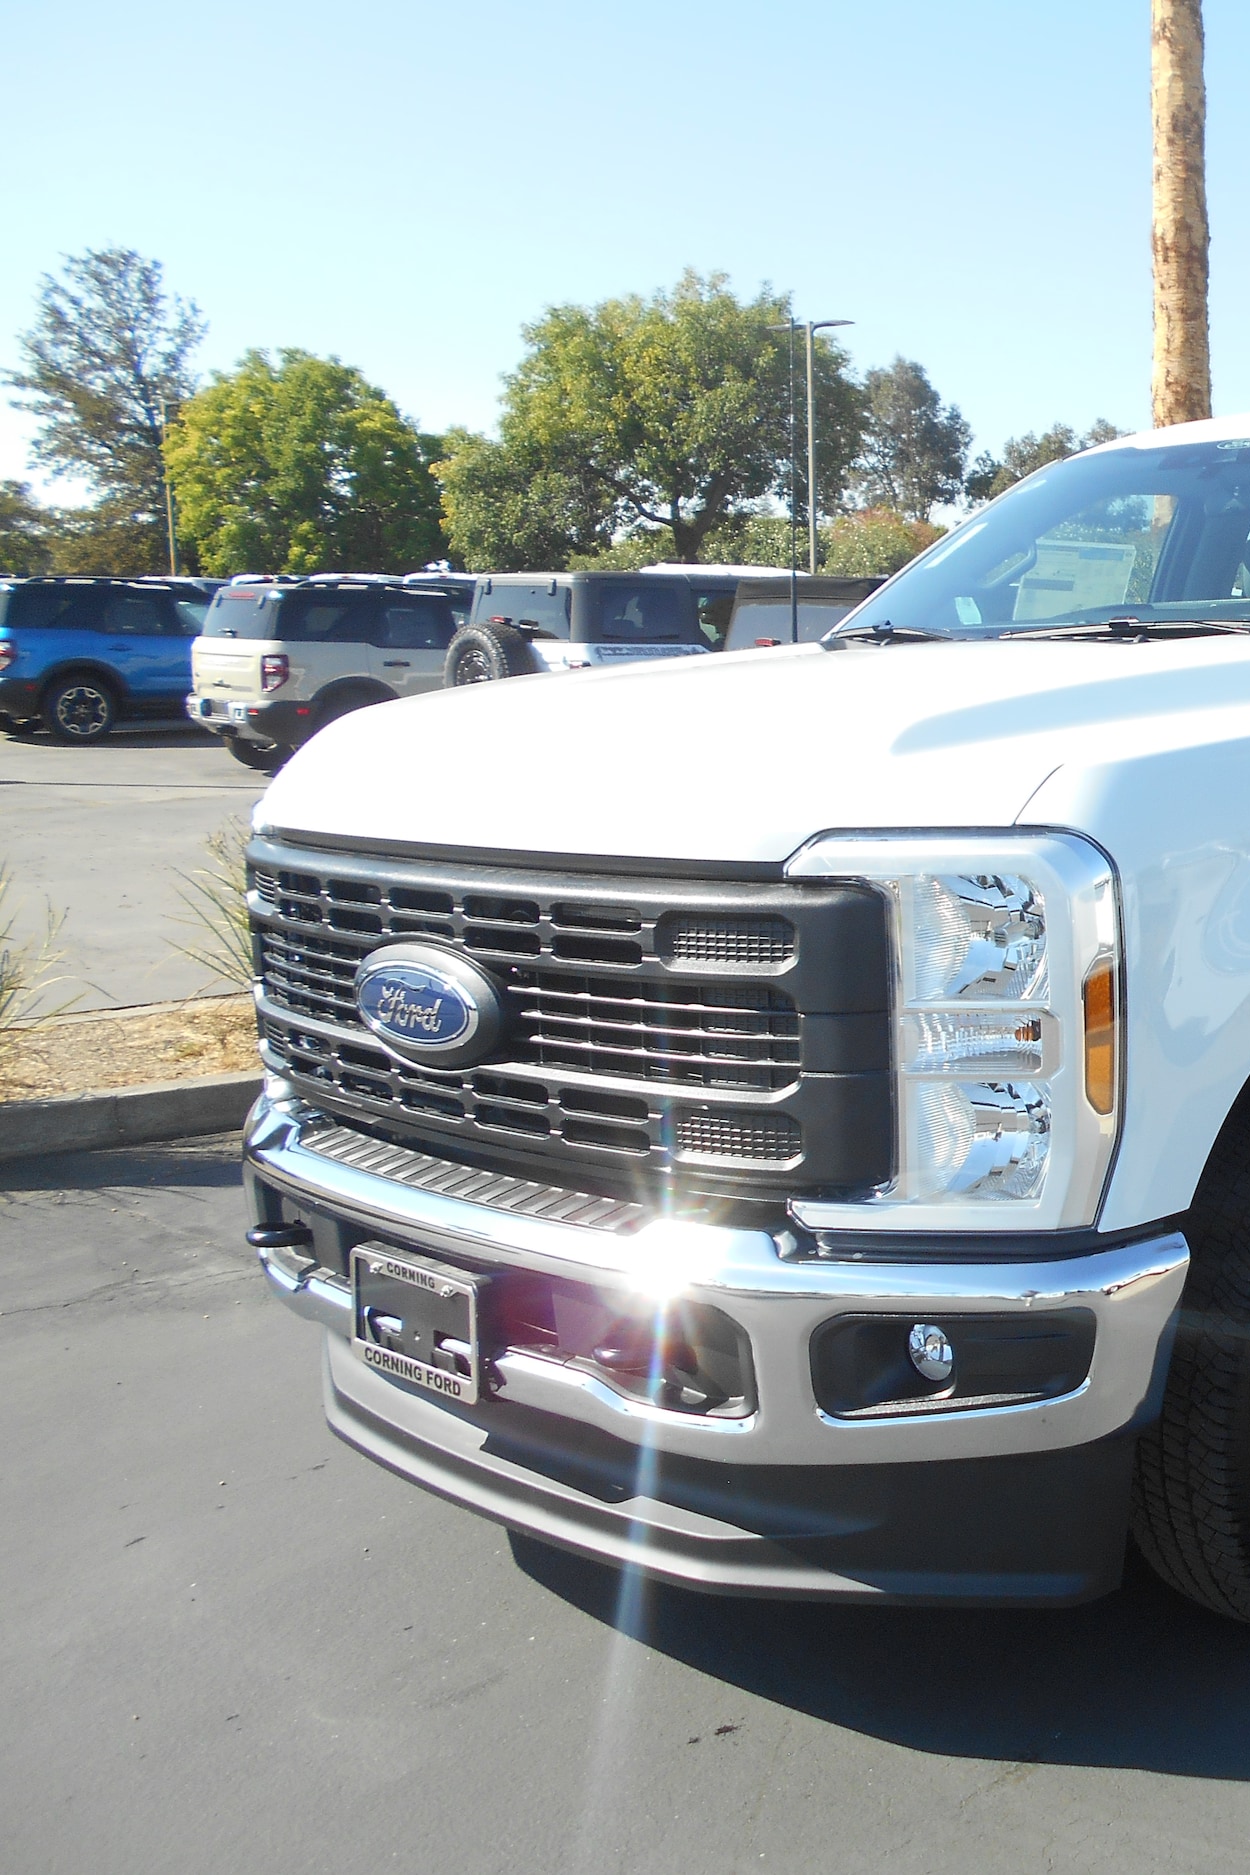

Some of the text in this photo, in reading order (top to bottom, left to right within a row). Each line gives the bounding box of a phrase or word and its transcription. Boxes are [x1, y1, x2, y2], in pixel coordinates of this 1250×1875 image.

[377, 977, 443, 1033] Ford
[386, 1261, 436, 1289] CORNING
[364, 1347, 462, 1397] CORNING FORD
